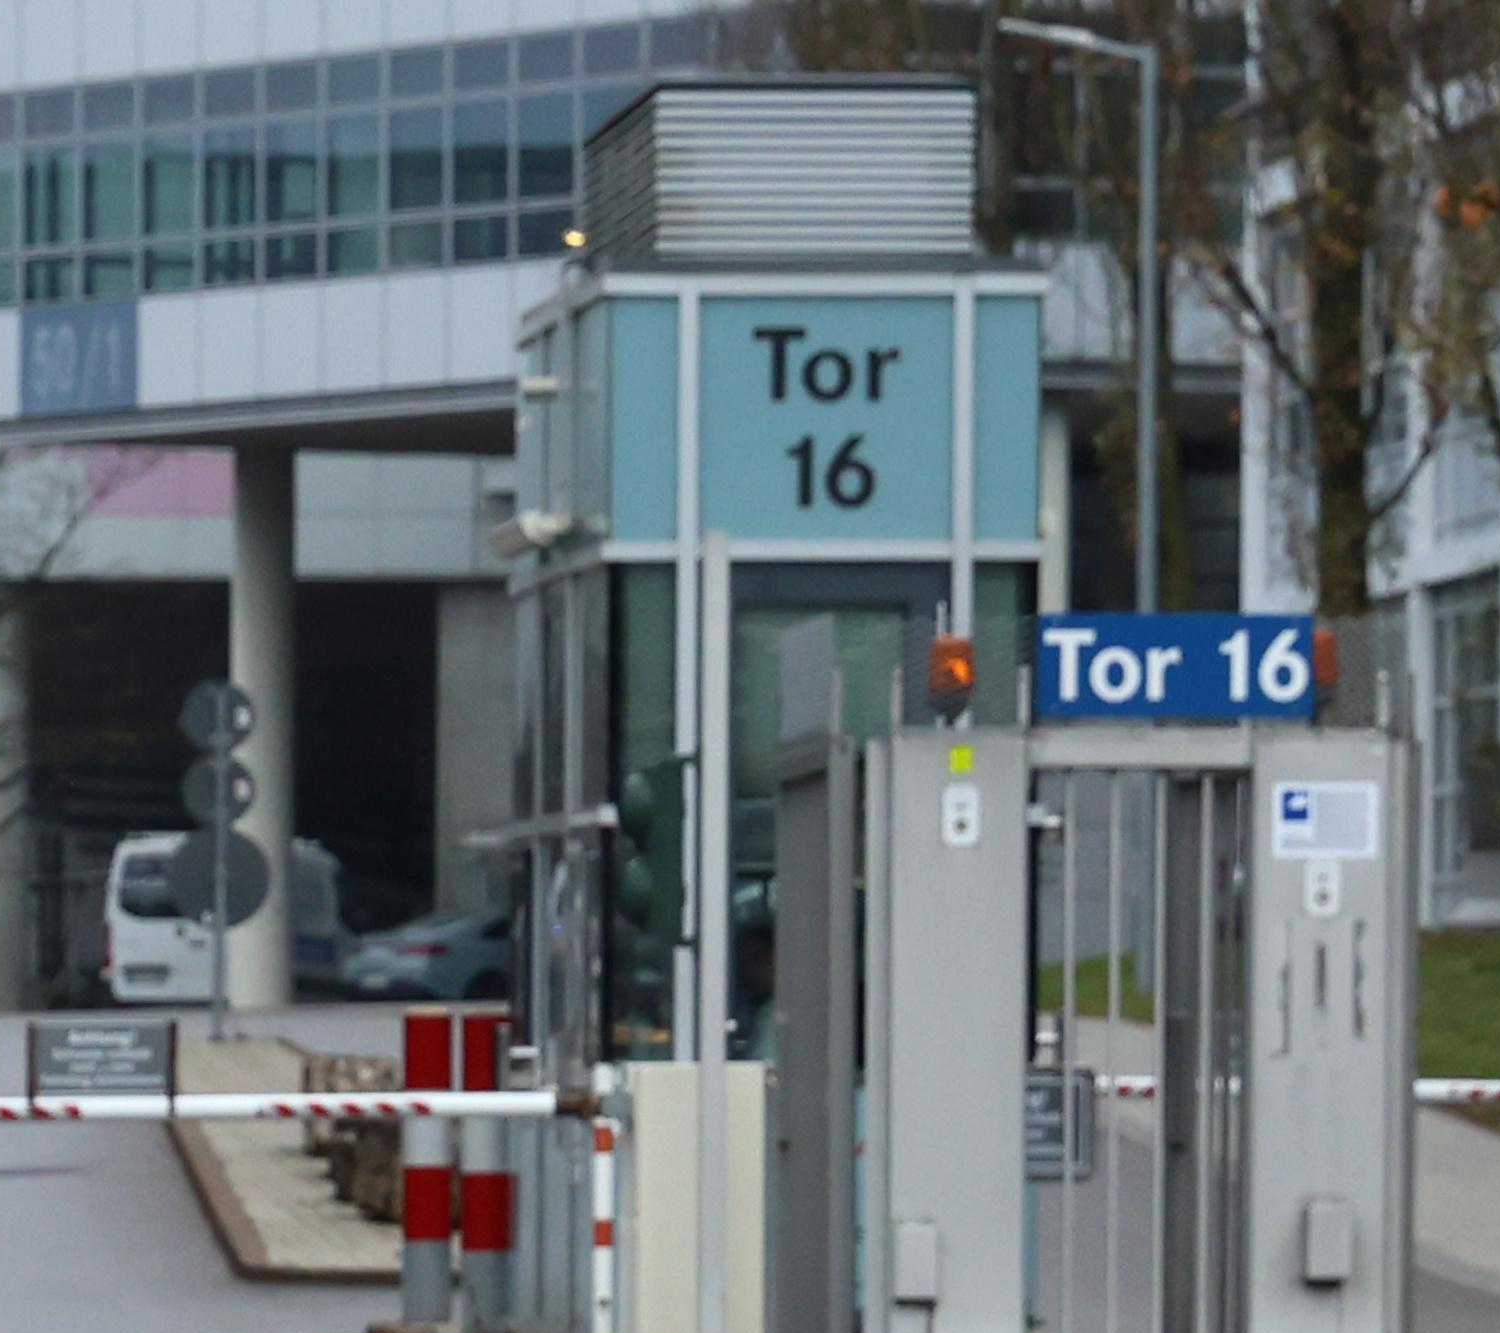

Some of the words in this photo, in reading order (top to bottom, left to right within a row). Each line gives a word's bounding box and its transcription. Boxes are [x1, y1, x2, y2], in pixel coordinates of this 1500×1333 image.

[753, 326, 902, 403] Tor
[786, 433, 876, 509] 16
[1042, 627, 1183, 703] Tor
[1218, 628, 1310, 703] 16
